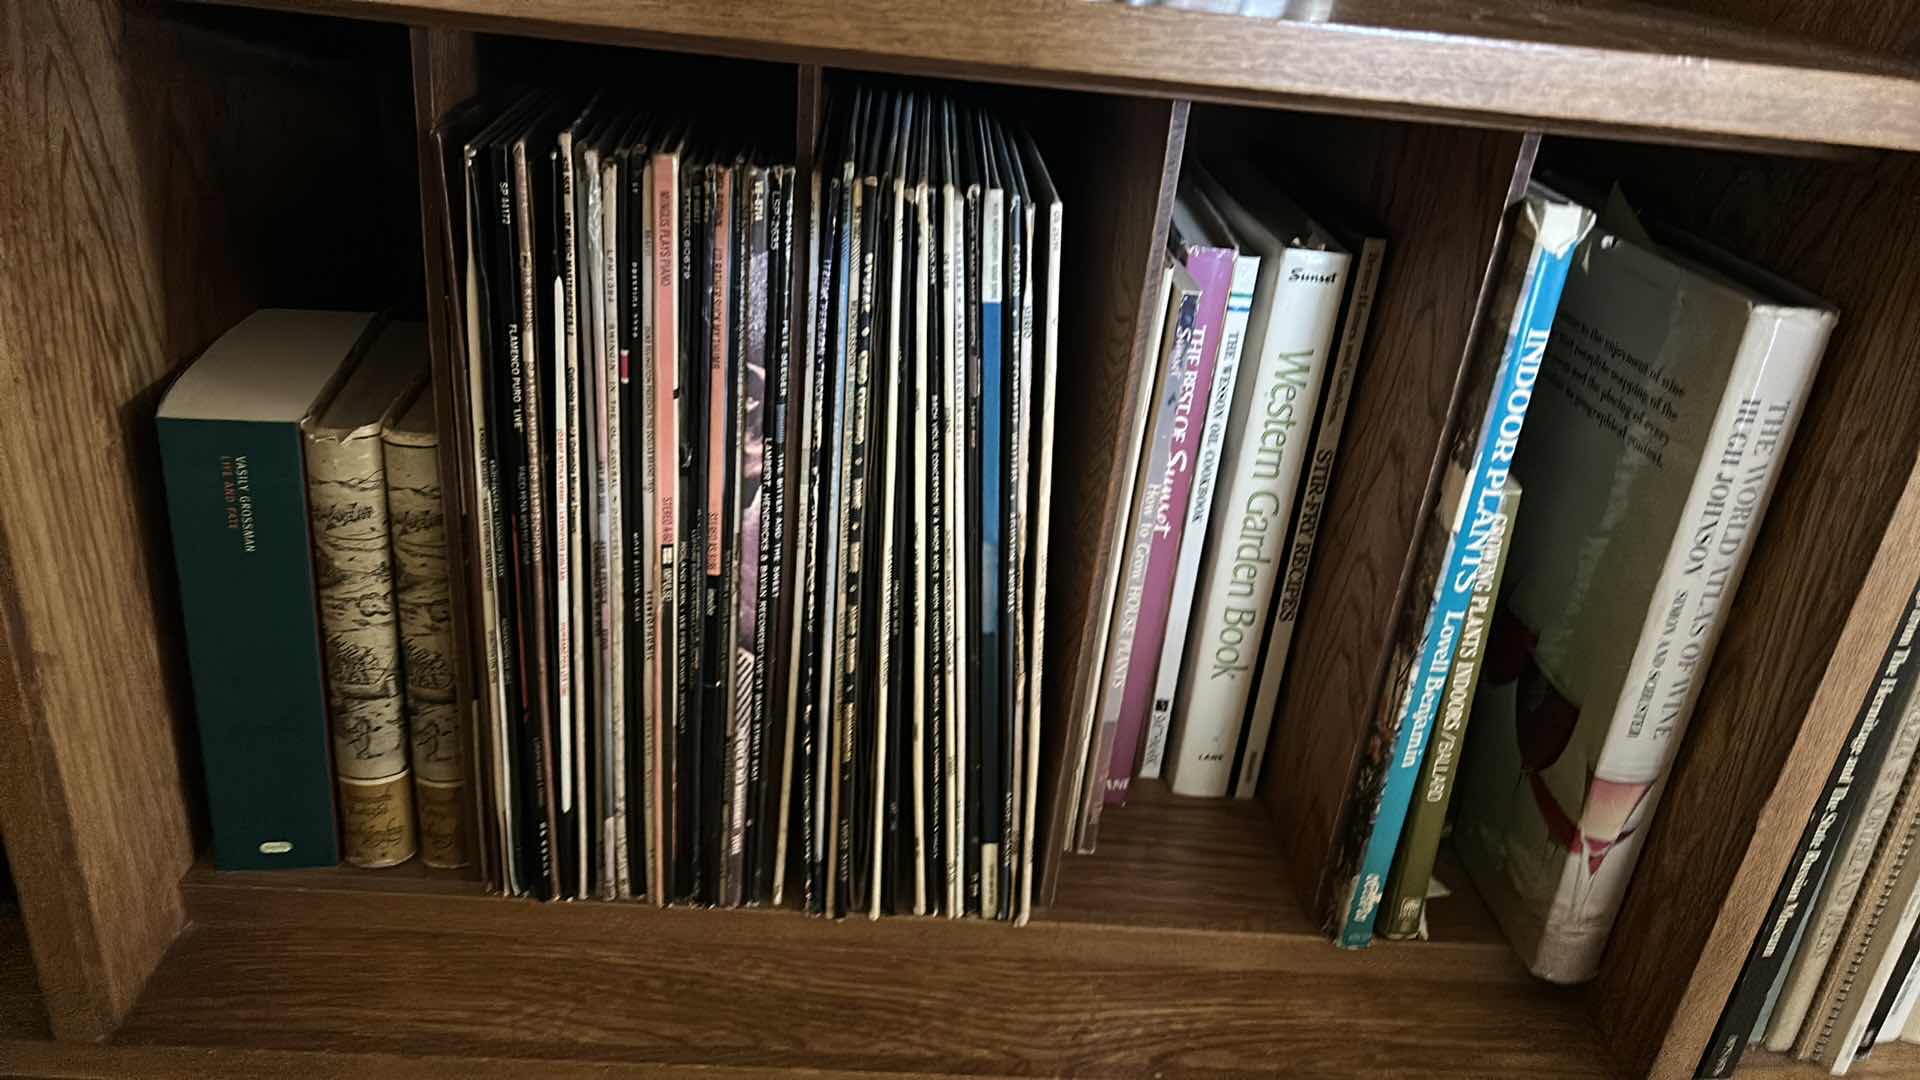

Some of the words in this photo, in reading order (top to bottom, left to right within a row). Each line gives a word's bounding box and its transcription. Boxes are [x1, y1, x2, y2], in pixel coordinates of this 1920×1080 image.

[659, 191, 671, 228] MINGUS
[660, 229, 671, 258] PLAYS
[660, 259, 671, 288] PIANO
[1012, 243, 1021, 297] CHOPIN
[1288, 267, 1338, 286] Sunset
[507, 324, 520, 377] FLAMENCO
[1169, 325, 1192, 377] Sunset
[1186, 325, 1207, 364] THE
[1223, 331, 1239, 362] THE
[512, 377, 522, 404] PURO
[779, 351, 789, 398] SEEGER
[1211, 364, 1234, 420] WESSON
[1490, 327, 1553, 465] INDOOR
[930, 394, 939, 420] BACH
[1171, 415, 1188, 443] OF
[1251, 347, 1316, 482] Western
[1720, 399, 1762, 466] HUGH
[1752, 399, 1792, 458] THE
[930, 421, 940, 452] VIOLIN
[1207, 421, 1223, 447] OIL
[219, 456, 235, 477] LIFE
[234, 455, 248, 491] VASILY
[776, 452, 785, 475] THE
[930, 452, 940, 504] CONCERTOS
[1191, 449, 1219, 524] COOKBOOK
[223, 480, 236, 503] AND
[225, 506, 239, 529] FATE
[1140, 483, 1162, 515] How
[1154, 448, 1188, 540] Sunset
[1296, 448, 1336, 538] STIR-FRY
[1718, 463, 1769, 557] WORLD
[239, 495, 256, 553] GROSSMAN
[760, 492, 771, 552] HENDRICKS
[774, 516, 784, 541] AND
[1138, 522, 1153, 539] to
[1226, 489, 1281, 600] Garden
[1452, 465, 1511, 595] PLANTS
[1683, 472, 1735, 576] JOHNSON
[773, 543, 783, 564] THE
[1130, 542, 1151, 580] Grow
[1472, 513, 1509, 593] GROWING
[1120, 585, 1147, 635] HOUSE
[1279, 543, 1314, 625] RECIPES
[1692, 565, 1731, 638] ATLAS
[1457, 595, 1490, 658] PLANTS
[1661, 590, 1689, 637] SIMON
[1111, 638, 1134, 690] PLANTS
[1210, 606, 1258, 681] Book
[1427, 610, 1467, 672] Lovell
[1651, 639, 1672, 670] AND
[1677, 643, 1703, 675] OF
[1885, 647, 1912, 678] The
[1400, 674, 1447, 770] Benjamin
[1440, 661, 1475, 732] INDOORS
[1626, 671, 1661, 739] SCHUSTER
[1651, 677, 1692, 741] WINE
[1849, 678, 1898, 758] Hermitage
[1197, 752, 1224, 762] LANE
[1836, 756, 1859, 787] and
[1824, 786, 1850, 814] The
[1807, 810, 1839, 850] State
[1783, 848, 1823, 905] Russian
[1761, 902, 1800, 960] Museum
